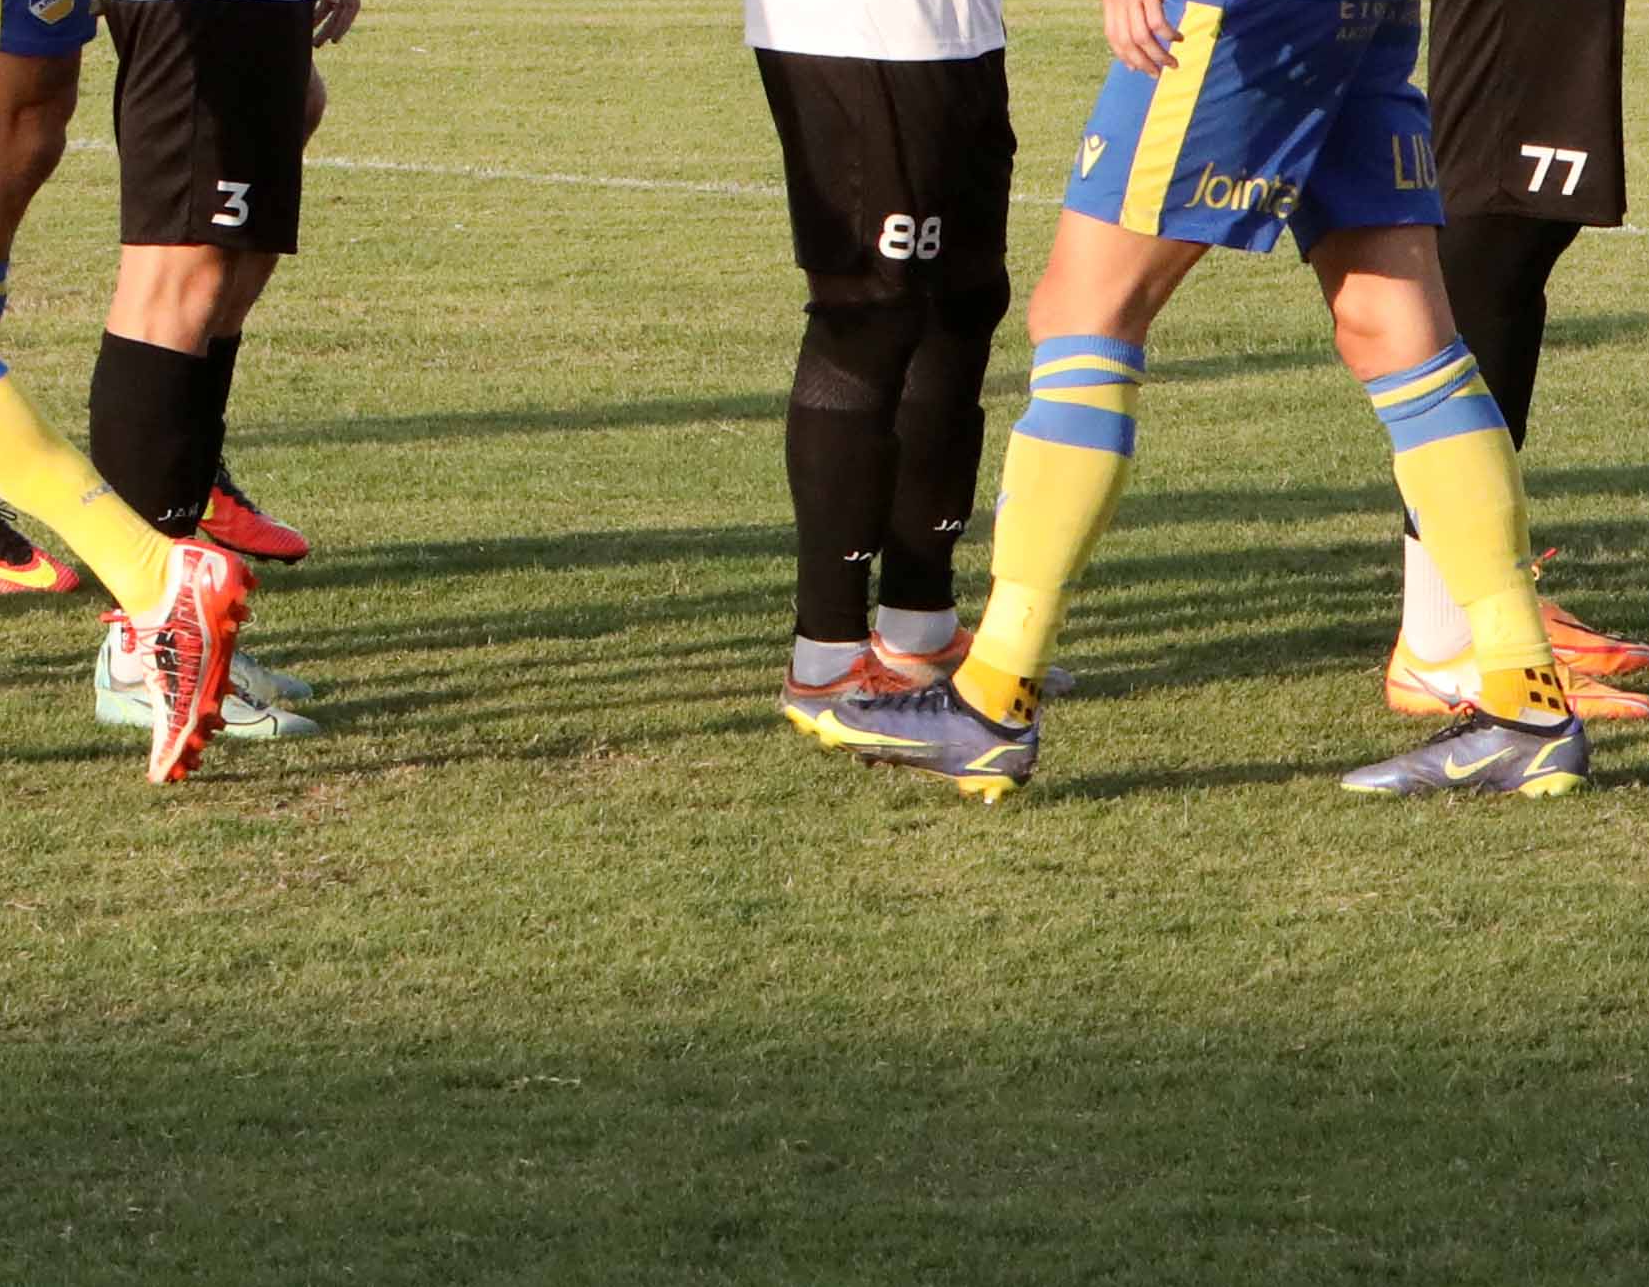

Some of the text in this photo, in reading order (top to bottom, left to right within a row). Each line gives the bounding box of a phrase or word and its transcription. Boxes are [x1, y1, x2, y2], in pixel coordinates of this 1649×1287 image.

[1520, 143, 1589, 196] 77
[211, 179, 252, 227] 3
[878, 213, 942, 260] 88
